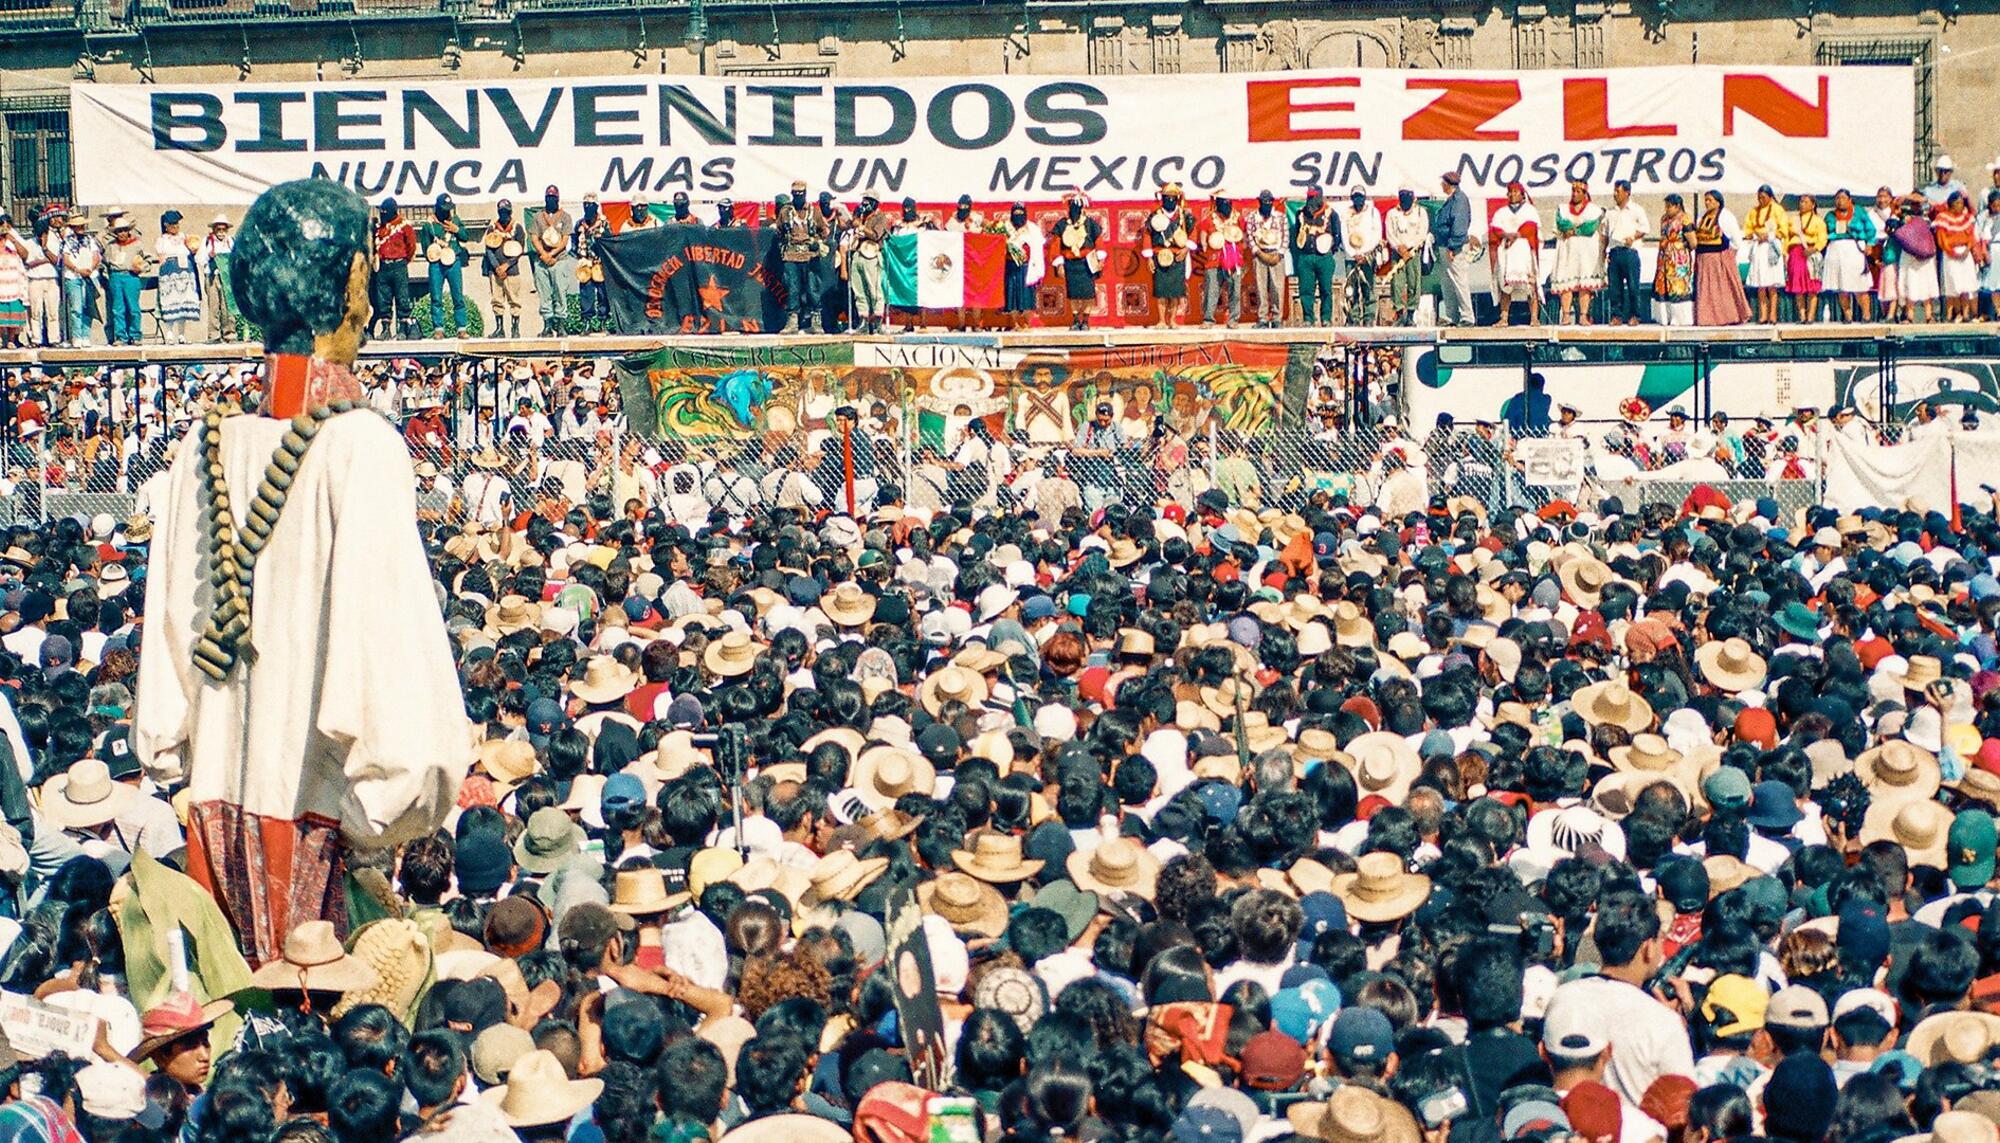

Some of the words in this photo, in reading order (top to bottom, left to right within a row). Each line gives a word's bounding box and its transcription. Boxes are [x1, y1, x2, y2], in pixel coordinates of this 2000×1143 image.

[150, 82, 1109, 152] BIENVENIDOS
[1247, 74, 1829, 143] EZLN
[311, 158, 528, 196] NUNCA
[600, 156, 736, 192] MAS
[827, 157, 908, 191] UN
[989, 154, 1226, 192] MEXICO
[1289, 151, 1383, 188] SIN
[1456, 147, 1727, 188] NOSOTROS
[683, 246, 746, 270] LIBERTAD
[1103, 343, 1235, 368] INDIGENA
